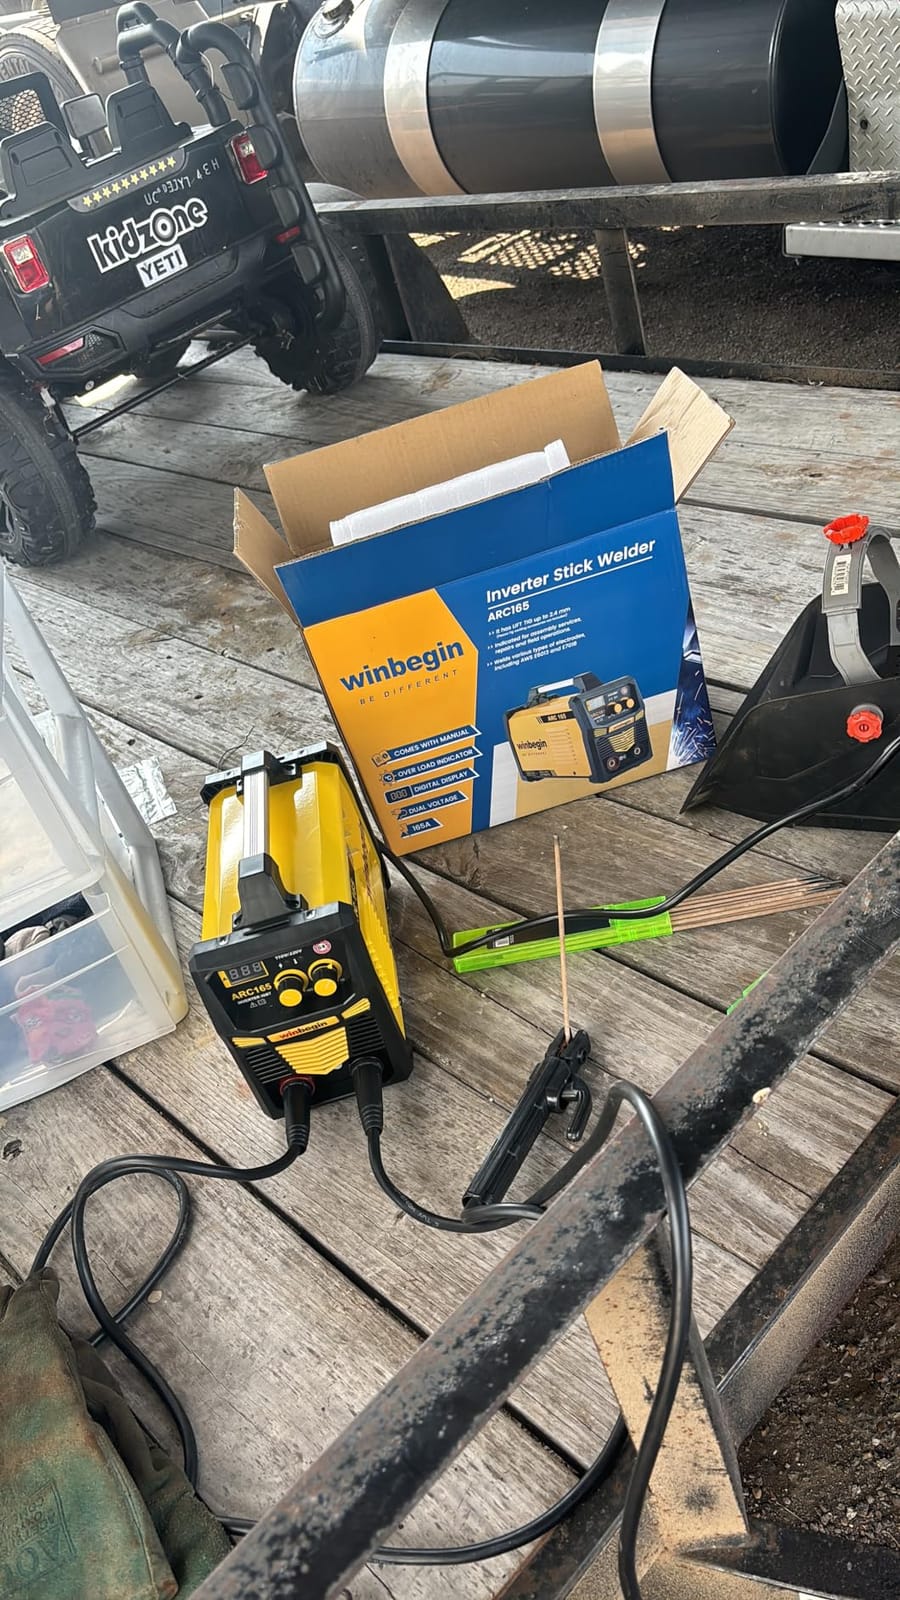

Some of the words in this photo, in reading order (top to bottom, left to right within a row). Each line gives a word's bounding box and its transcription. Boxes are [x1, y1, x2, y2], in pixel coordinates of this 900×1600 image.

[140, 249, 184, 280] YETI
[486, 574, 549, 604] Inverter
[553, 558, 594, 582] Stick
[597, 539, 656, 568] Welder
[487, 601, 530, 623] ARC165
[339, 641, 464, 692] winbegin
[359, 695, 375, 705] BE
[383, 669, 457, 698] DIFFERENT
[393, 744, 420, 757] COMES
[420, 738, 440, 749] WITH
[439, 728, 470, 742] MANUAL
[397, 765, 417, 777] OVER
[417, 760, 436, 772] LOAD
[436, 748, 474, 766] INDICATOR
[413, 780, 440, 793] DIGITAL
[440, 770, 469, 785] DISPLAY
[408, 804, 427, 815] DUAL
[427, 794, 459, 808] VOLTAGE
[411, 820, 431, 831] 165A
[231, 982, 273, 1001] ARC165
